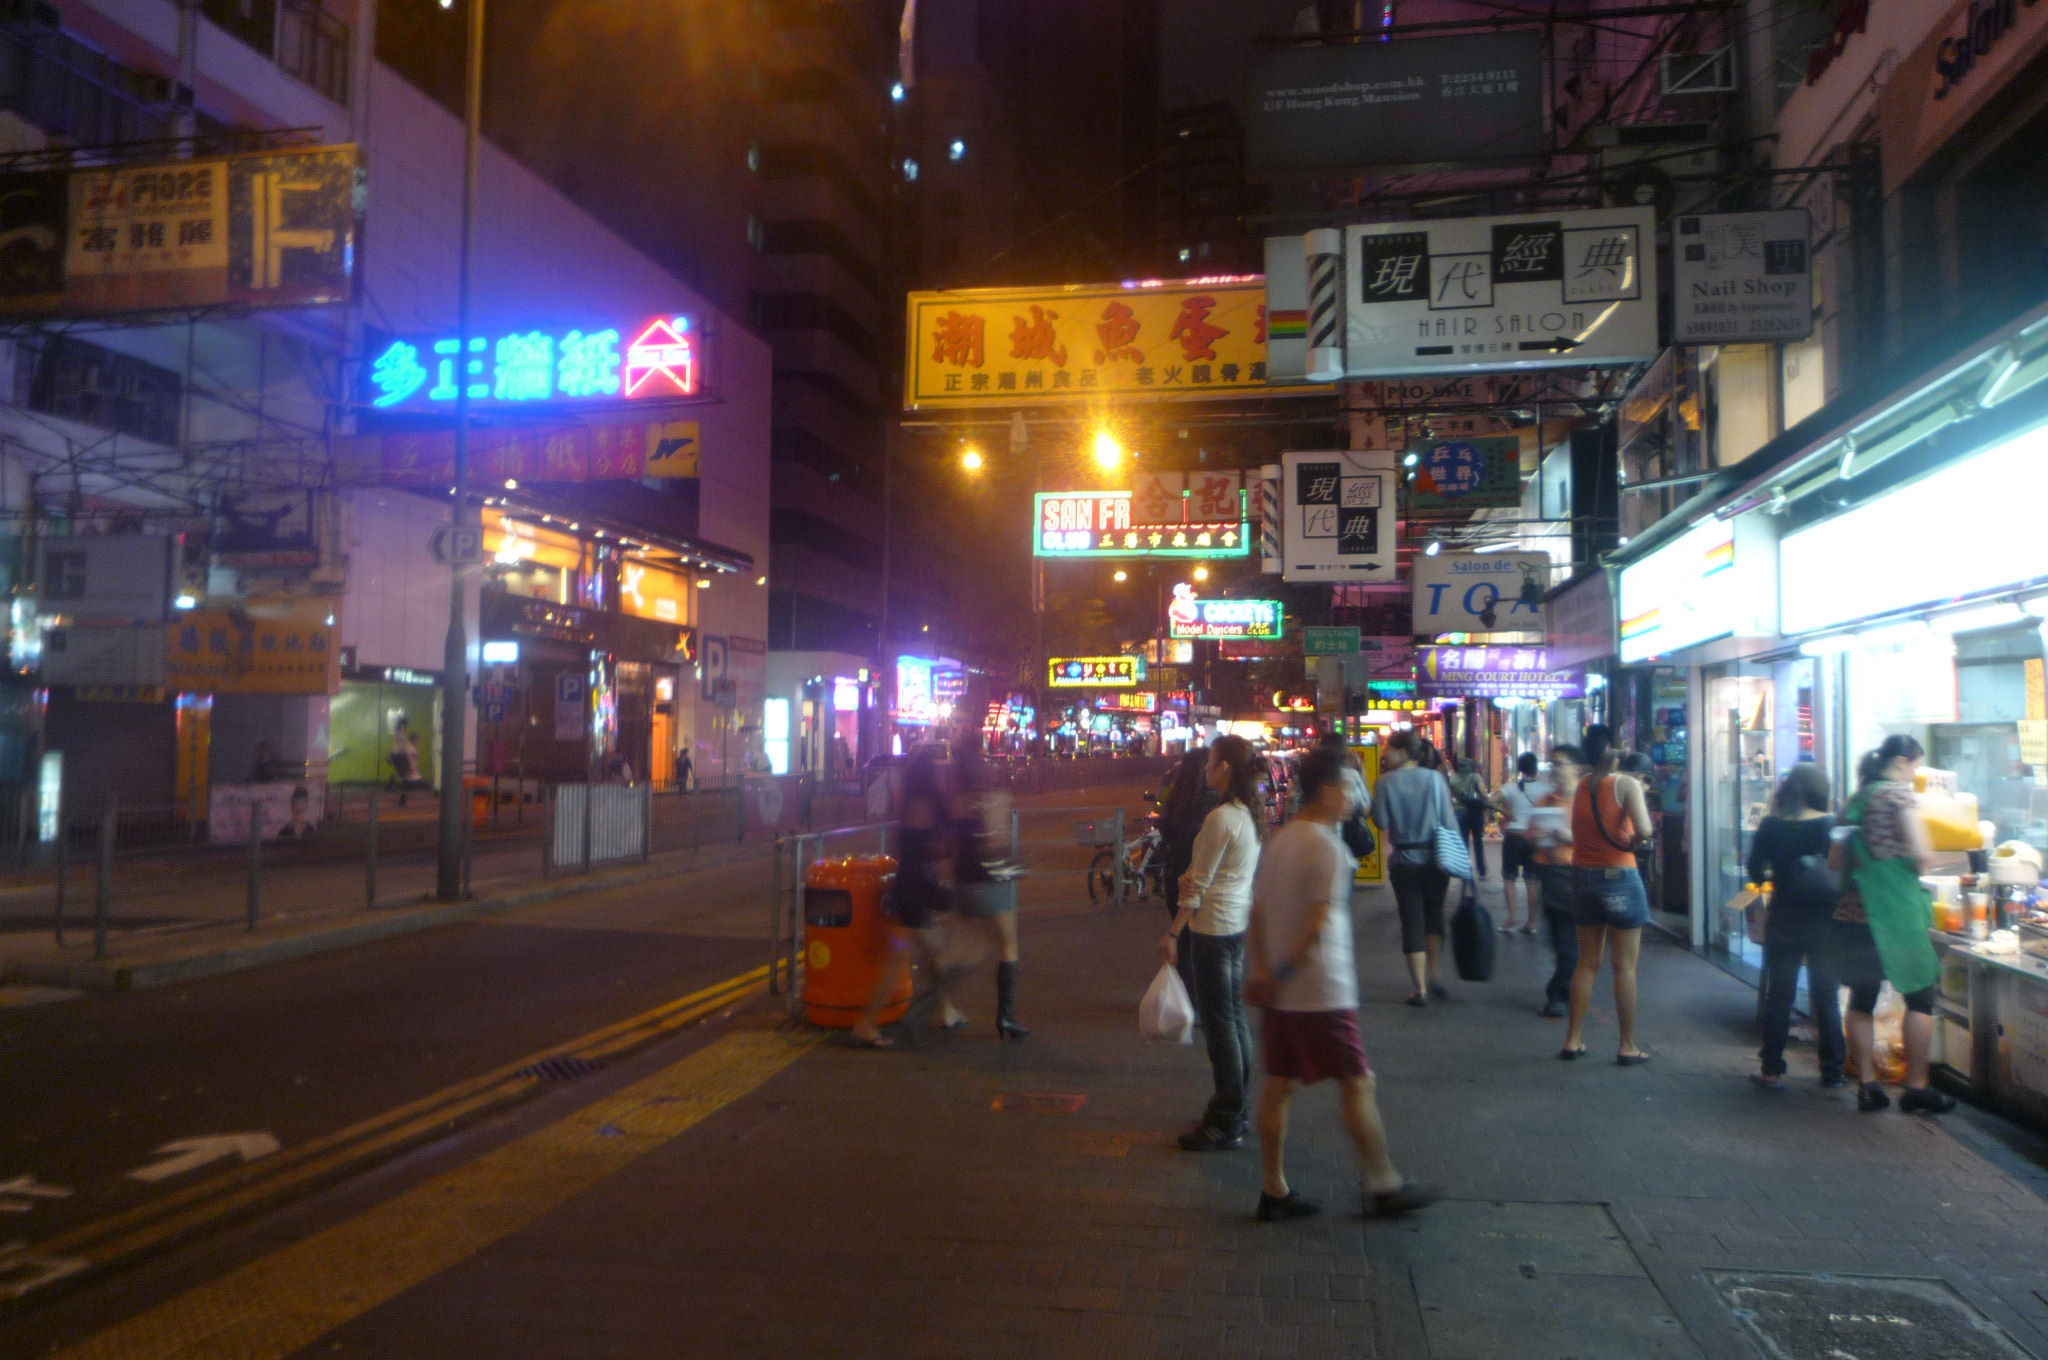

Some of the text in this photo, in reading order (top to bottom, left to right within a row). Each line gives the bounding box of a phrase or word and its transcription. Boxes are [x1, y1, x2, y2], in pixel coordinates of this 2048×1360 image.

[1287, 98, 1322, 111] Hong
[1324, 96, 1359, 107] Kong
[1362, 91, 1421, 104] Mansion
[1692, 278, 1797, 297] Nail Shop
[932, 295, 1266, 368] 潮城魚蛋
[1418, 311, 1585, 338] HAIR SALON
[1044, 499, 1093, 531] SAN
[1043, 531, 1091, 550] CLUB
[1452, 559, 1512, 572] Salon de
[1176, 623, 1243, 636] Model Dancers
[1441, 671, 1559, 682] MING COURT HOTEL
